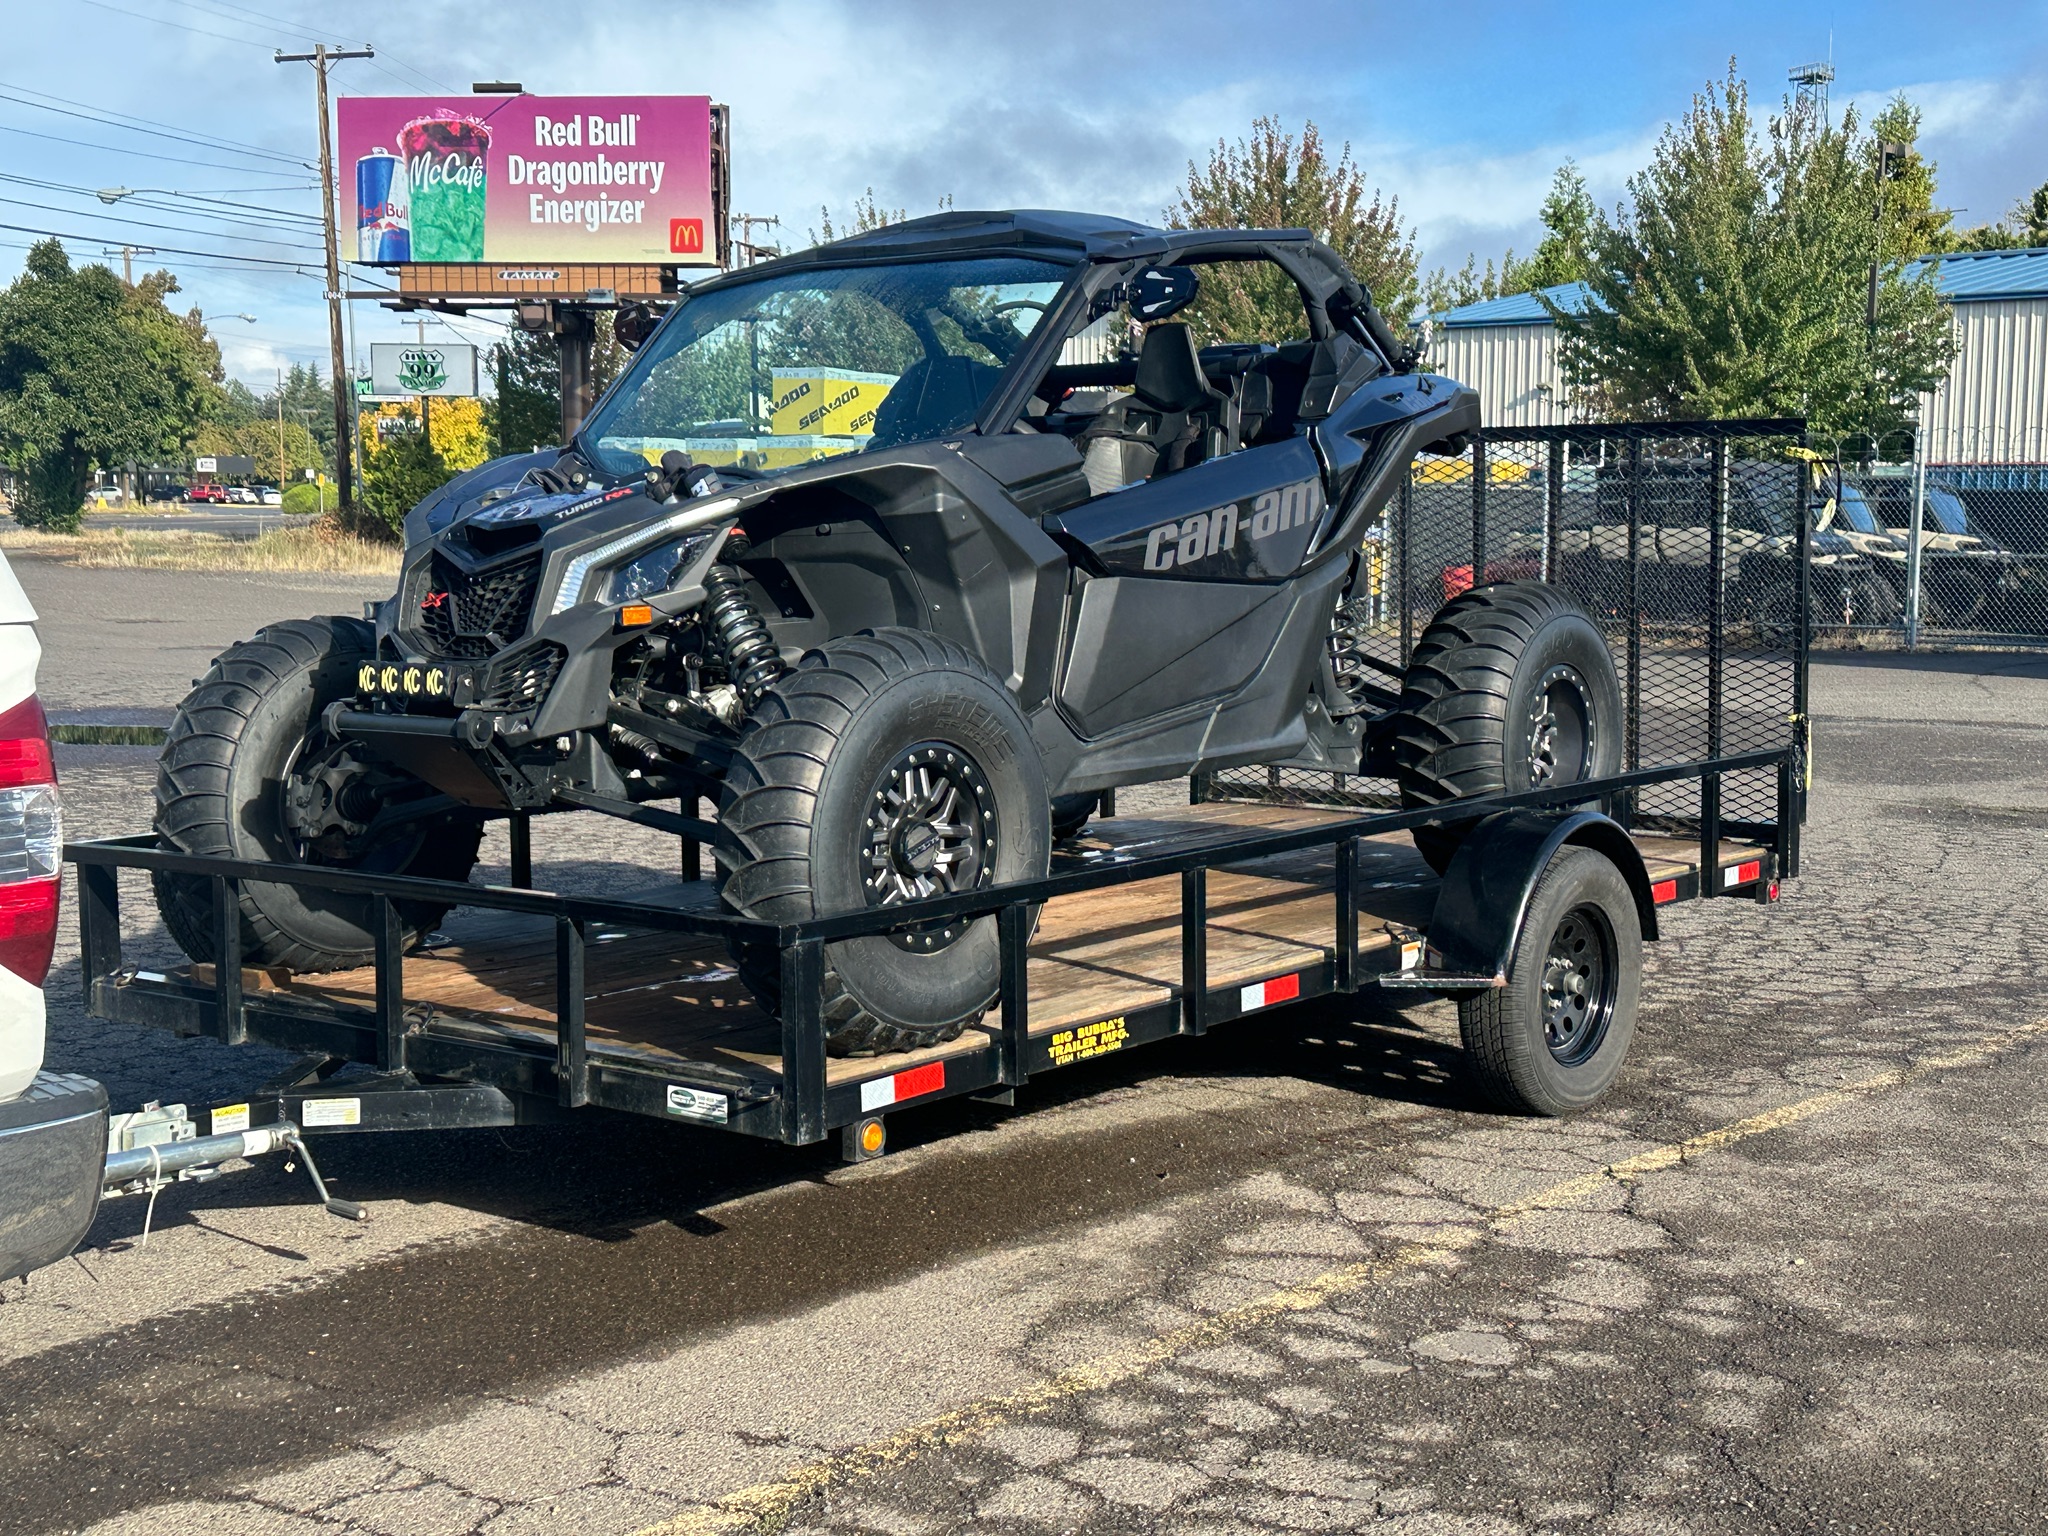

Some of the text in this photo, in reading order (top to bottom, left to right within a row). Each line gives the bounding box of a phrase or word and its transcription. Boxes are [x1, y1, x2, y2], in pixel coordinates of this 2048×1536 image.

[535, 115, 581, 146] Red
[410, 151, 483, 194] McCafé
[508, 153, 665, 194] Dragonberry
[530, 192, 645, 232] Energizer
[503, 271, 555, 280] LAMAR
[405, 353, 438, 361] HWY
[410, 364, 435, 379] 99
[554, 498, 604, 519] TURBO
[1143, 476, 1320, 571] can-am
[359, 665, 444, 695] KC KC KC KC
[1048, 1028, 1130, 1058] TRAILER MFG.
[1052, 1016, 1125, 1046] BIG BUBBA'S
